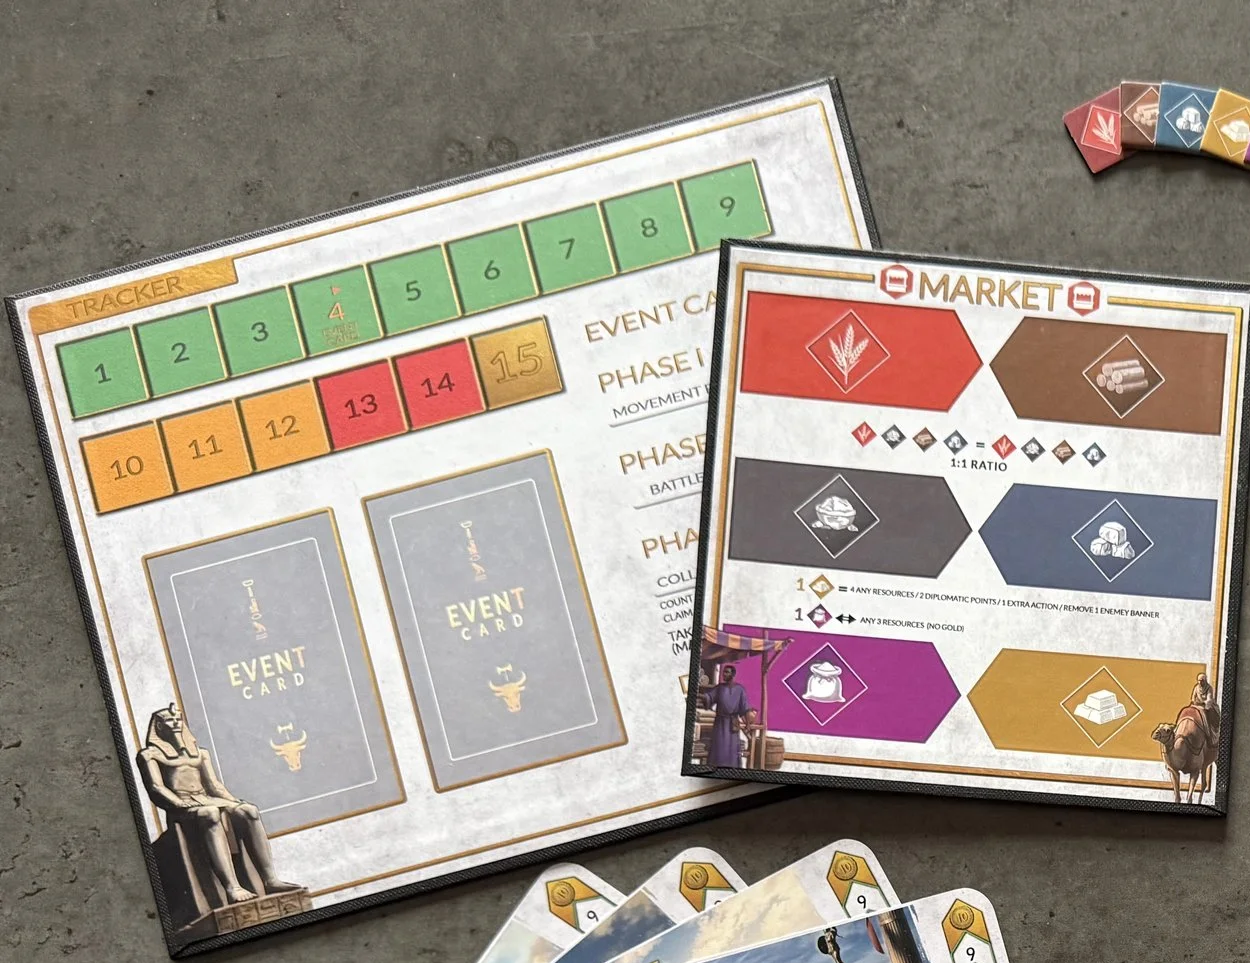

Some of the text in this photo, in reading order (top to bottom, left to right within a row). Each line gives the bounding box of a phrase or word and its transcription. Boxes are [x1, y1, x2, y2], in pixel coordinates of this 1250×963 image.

[720, 196, 736, 217] 9
[640, 217, 660, 239] 8
[557, 238, 578, 260] 7
[483, 259, 502, 282] 6
[67, 275, 183, 322] TRACKER
[404, 279, 423, 302] 5
[918, 273, 1064, 313] MARKET
[327, 301, 347, 322] 4
[584, 300, 677, 343] EVENT
[250, 320, 270, 343] 3
[171, 341, 191, 364] 2
[488, 343, 544, 385] 15
[95, 363, 113, 384] 1
[420, 372, 457, 399] 14
[598, 351, 692, 394] PHASE
[344, 393, 379, 420] 13
[613, 385, 702, 419] MOVEMENT
[264, 415, 302, 441] 12
[188, 435, 224, 462] 11
[619, 433, 707, 475] PHASE
[110, 454, 145, 482] 10
[950, 458, 1008, 472] 1:1 RATIO
[796, 578, 806, 592] 1
[445, 587, 526, 629] EVENT
[659, 594, 694, 610] COUNT
[794, 608, 803, 622] 1
[855, 586, 871, 594] ANY
[872, 587, 914, 597] RESOURCES
[925, 592, 969, 602] DIPLOMATIC
[970, 596, 997, 604] POINTS
[1006, 599, 1031, 607] EXTRA
[1031, 601, 1060, 610] ACTION
[1063, 604, 1095, 613] REMOVE
[1100, 607, 1130, 616] ENEMEY
[1130, 609, 1161, 619] BANNER
[461, 613, 524, 642] CARD
[663, 609, 694, 623] CLAIM
[860, 616, 965, 631] ANY 3 RESOURCES (NO GOLD)
[227, 646, 306, 688] EVENT
[242, 672, 305, 701] CARD
